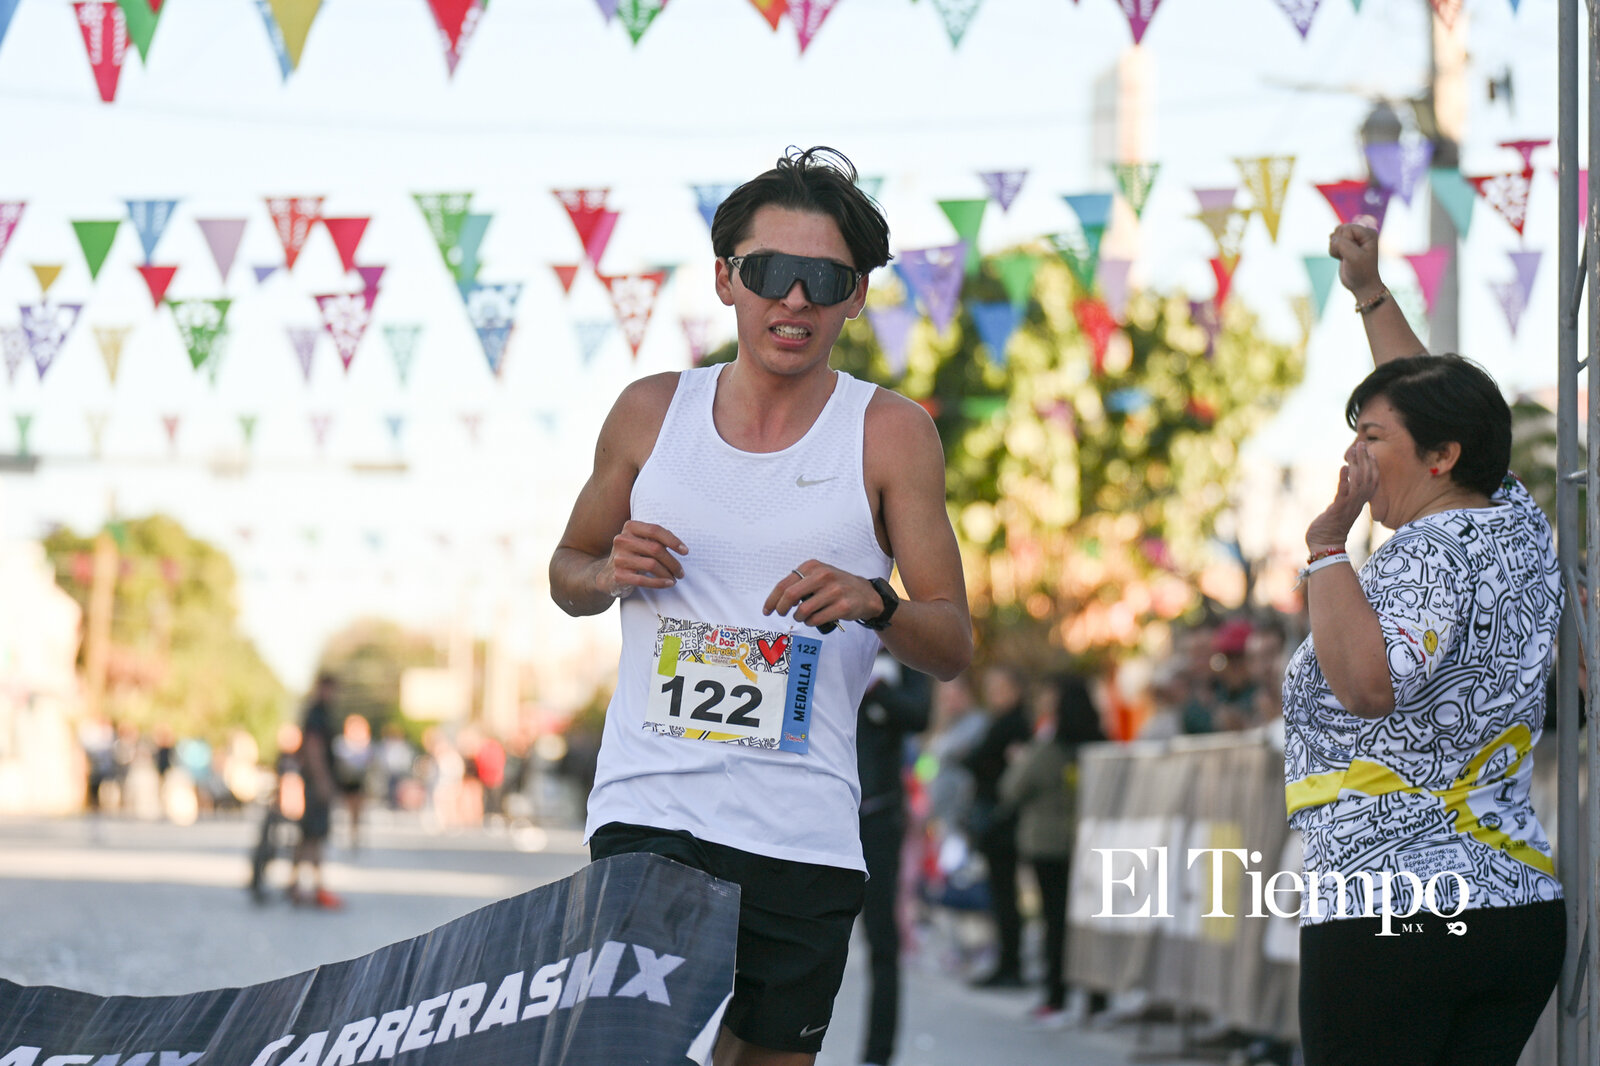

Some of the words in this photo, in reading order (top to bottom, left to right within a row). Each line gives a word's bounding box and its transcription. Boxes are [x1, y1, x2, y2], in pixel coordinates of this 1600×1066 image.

[797, 643, 817, 655] 122
[661, 675, 763, 729] 122
[793, 662, 812, 722] MEDALLA
[1403, 852, 1423, 861] CADA
